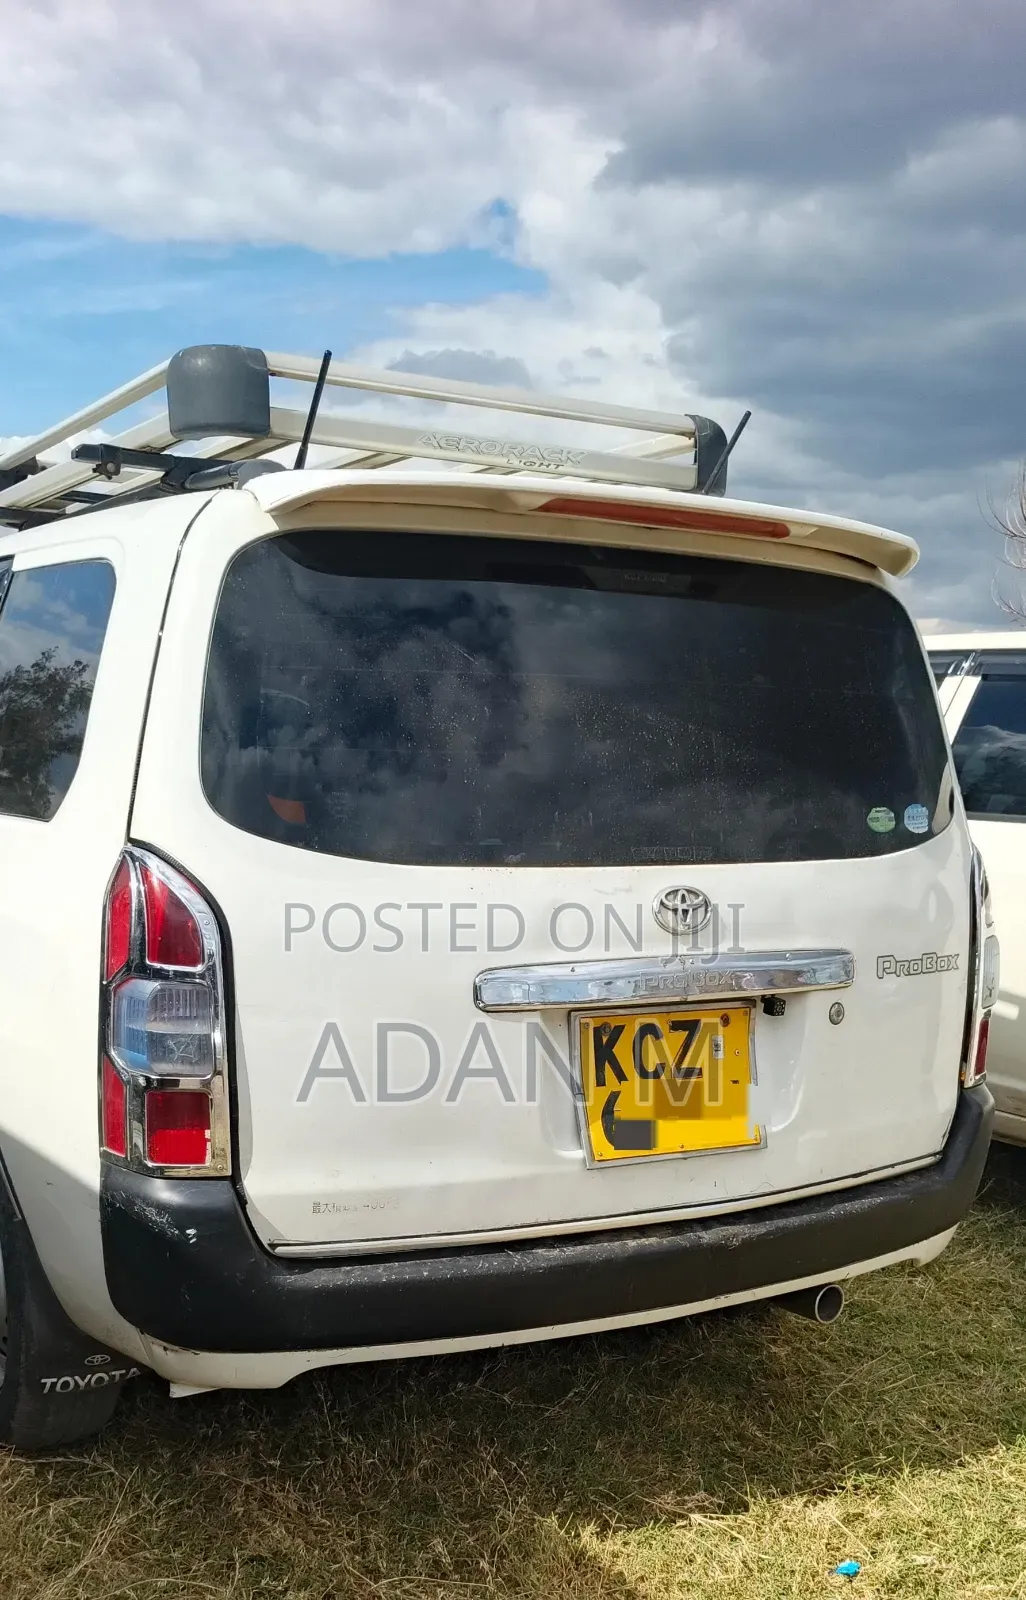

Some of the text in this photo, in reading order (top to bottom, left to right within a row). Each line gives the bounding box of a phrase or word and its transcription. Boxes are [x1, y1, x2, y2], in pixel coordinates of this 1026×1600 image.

[417, 433, 588, 465] AERORACK
[506, 458, 565, 470] LIGHT
[592, 1018, 703, 1087] KCZ
[40, 1367, 141, 1394] TOYOTA
